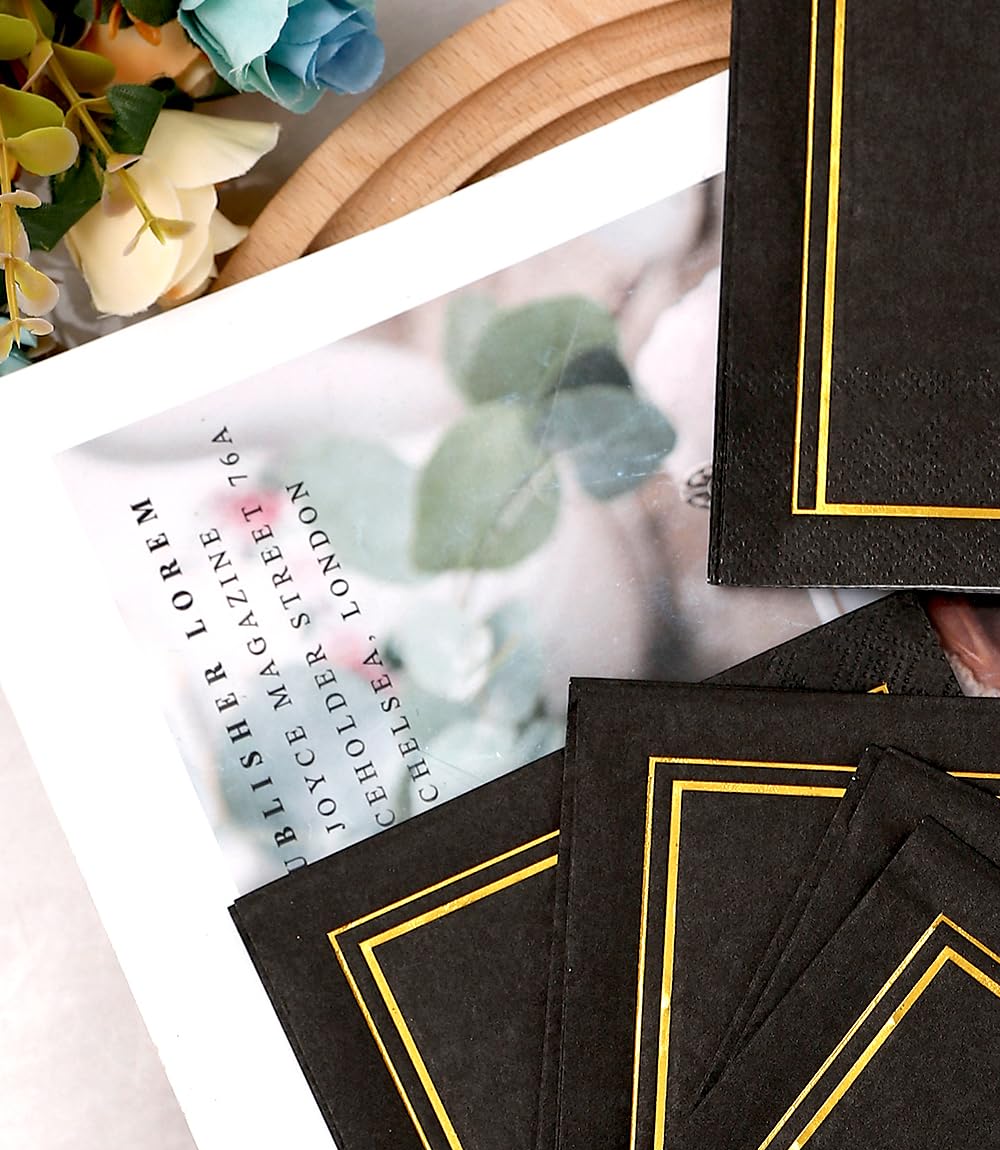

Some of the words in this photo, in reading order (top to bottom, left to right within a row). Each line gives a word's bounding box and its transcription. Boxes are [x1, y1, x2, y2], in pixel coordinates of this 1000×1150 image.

[211, 425, 248, 487] 76A
[130, 497, 208, 639] LOREM
[200, 527, 293, 711] MAGAZINE
[241, 504, 311, 629] STREET
[285, 480, 362, 621] LONDON
[204, 661, 308, 874] UBLISHER
[284, 725, 346, 834] JOYCE
[305, 644, 396, 828] CEHOLDER
[362, 634, 439, 803] CHELSEA,
